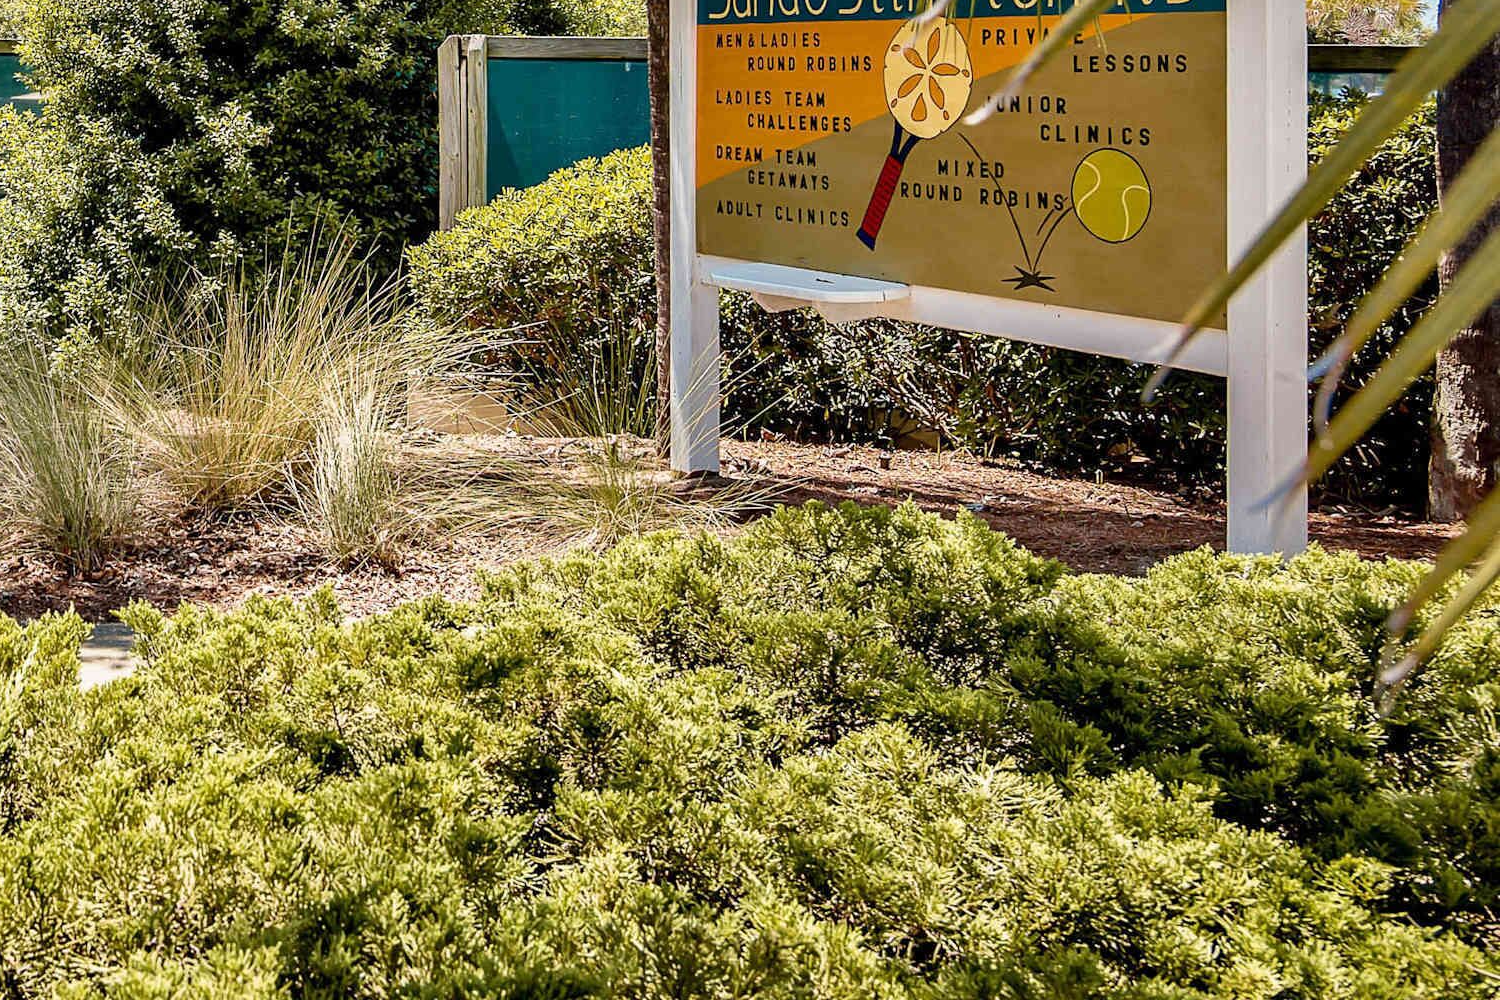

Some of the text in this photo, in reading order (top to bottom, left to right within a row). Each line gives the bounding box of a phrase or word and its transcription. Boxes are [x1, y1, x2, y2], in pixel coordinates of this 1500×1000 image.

[748, 56, 873, 72] ROUND ROBINS
[1073, 54, 1188, 73] LESSONS
[716, 90, 826, 108] LADIES TEAM
[985, 95, 1067, 114] UNIOR
[747, 113, 852, 133] CHALLENGES
[1040, 124, 1151, 146] CLINICS
[716, 145, 817, 168] DREAM TEAM
[938, 159, 1004, 179] MIXED
[747, 170, 830, 191] GETAWAYS
[900, 182, 1067, 212] ROUND ROBINS
[716, 200, 849, 227] ADULT CLINICS
